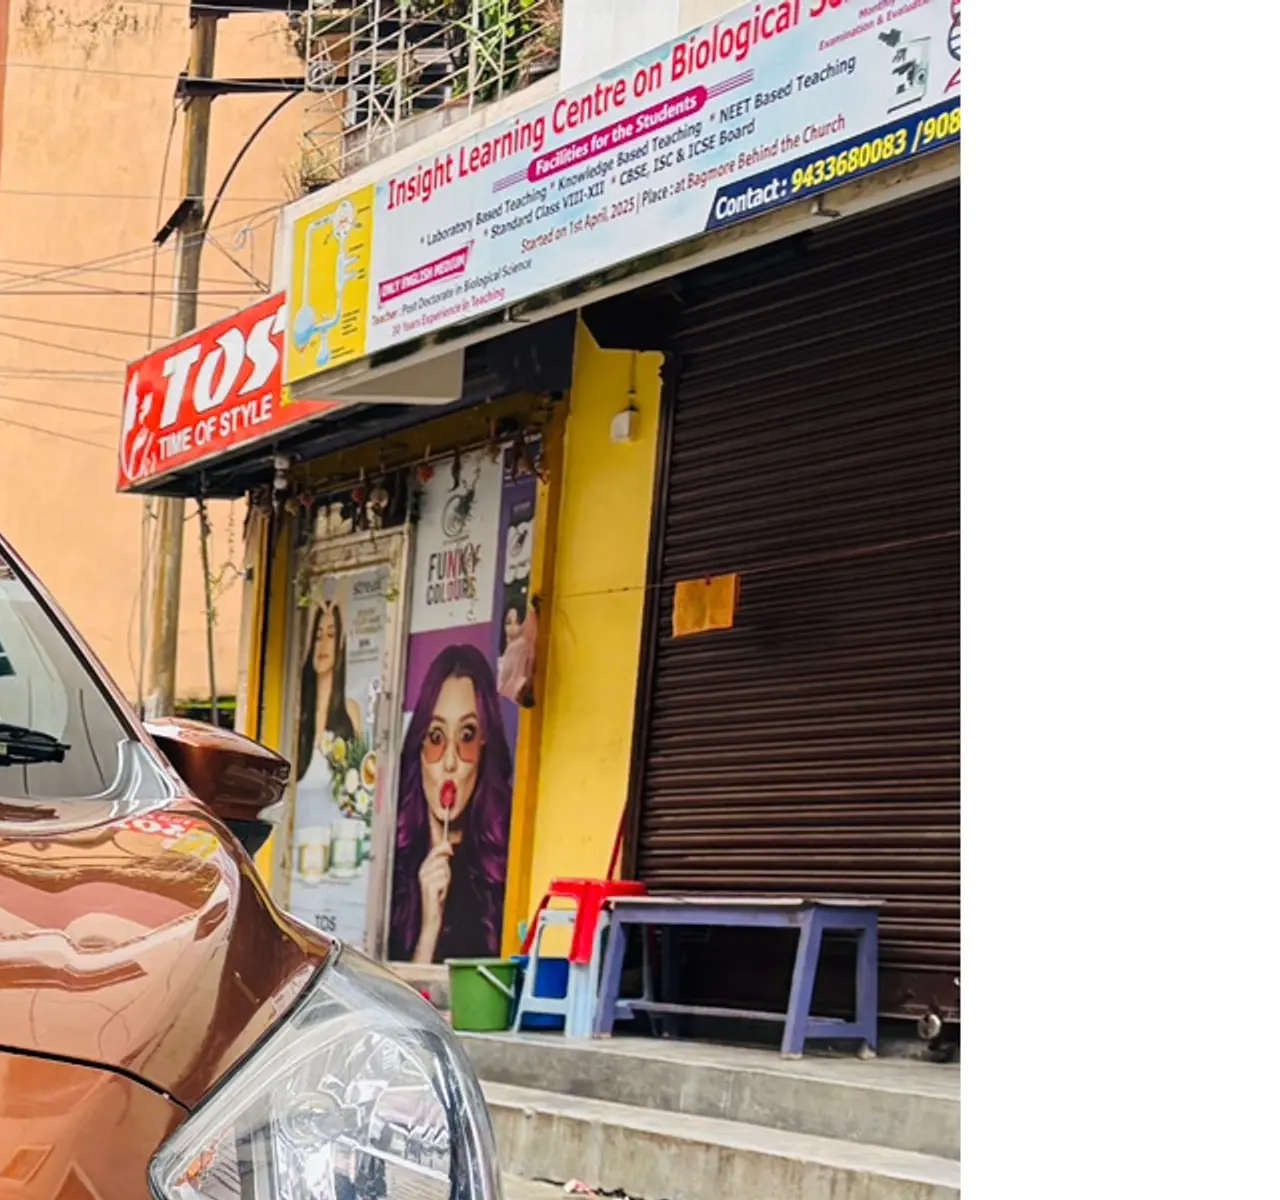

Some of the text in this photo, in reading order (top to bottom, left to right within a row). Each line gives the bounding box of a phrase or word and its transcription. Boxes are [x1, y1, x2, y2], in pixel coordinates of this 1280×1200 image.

[387, 0, 799, 210] Insight Learning Centre on Biological
[426, 56, 856, 246] Laboratory Based Teaching Knowledge Based Teaching NEET Based Teaching
[535, 95, 697, 176] Facilities for the Students
[491, 119, 756, 239] Standard Class VIII-XII CBSE, ISC & ICSE Board
[521, 226, 553, 252] Started
[555, 225, 567, 238] on
[570, 219, 583, 235] 1st
[611, 198, 635, 220] 2025
[738, 140, 778, 169] Behind
[781, 134, 799, 151] the
[803, 113, 845, 144] Church
[715, 178, 787, 220] Contact:
[791, 128, 907, 193] 9433680083
[159, 394, 273, 460] TIME OF STYLE
[160, 303, 286, 429] TOS
